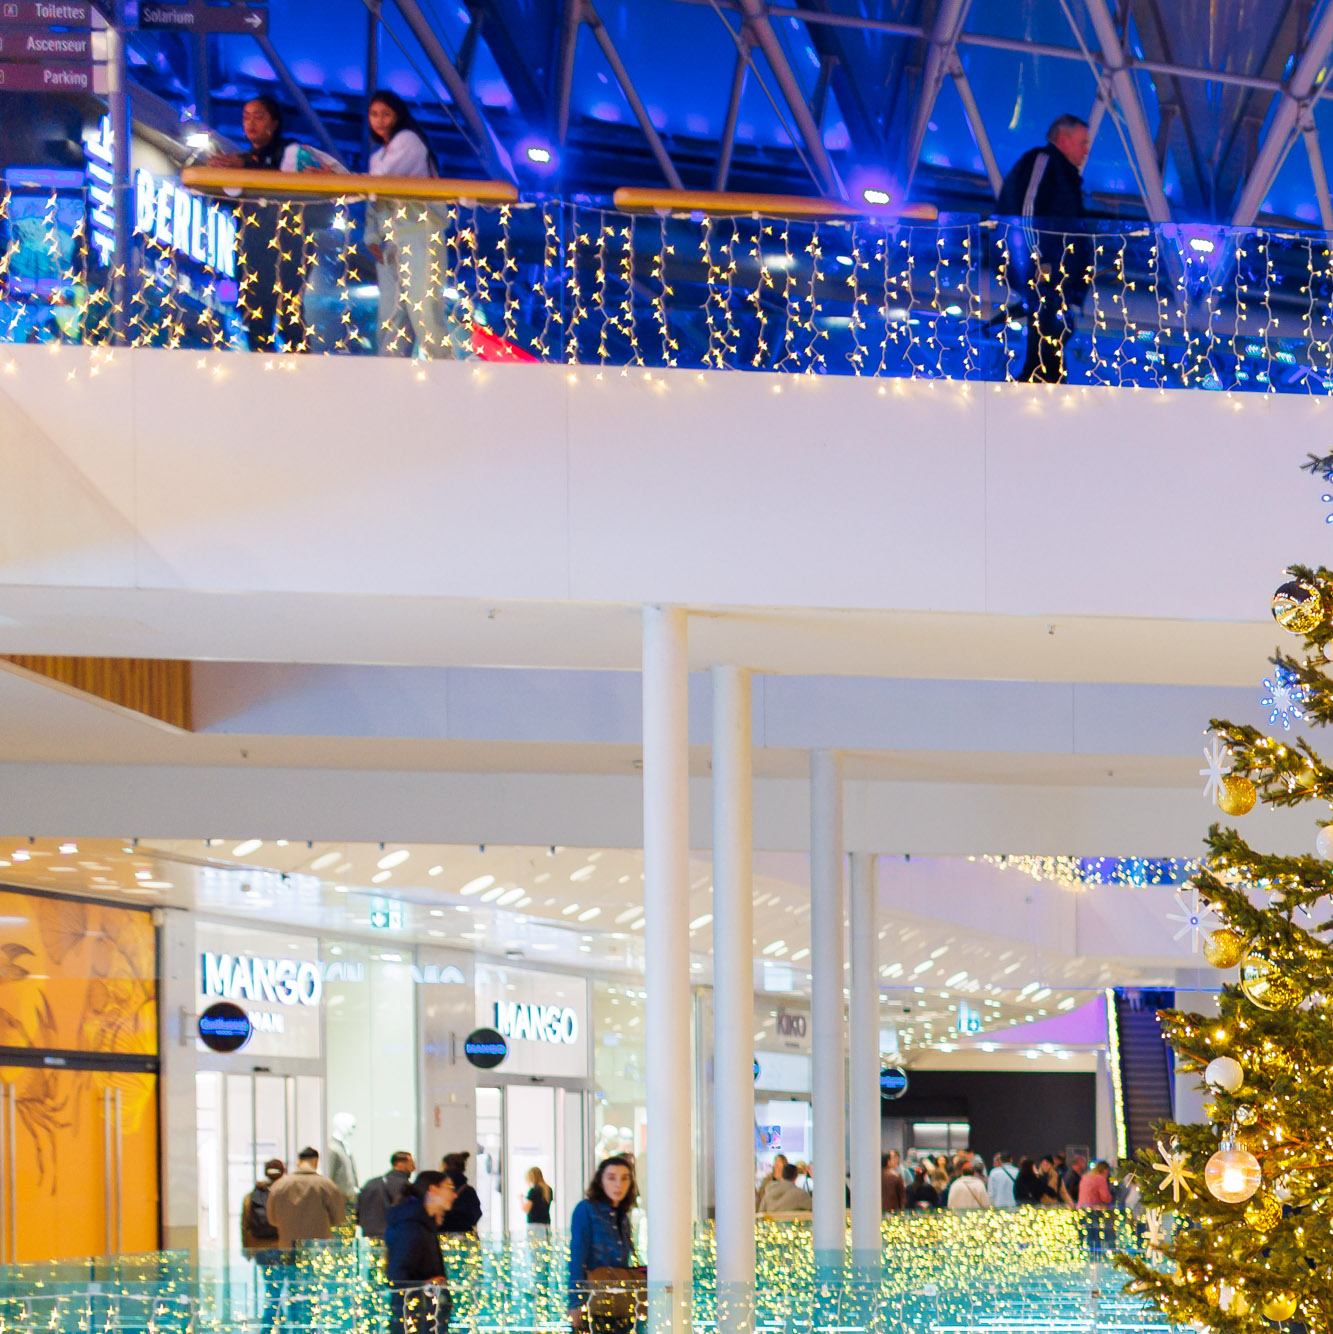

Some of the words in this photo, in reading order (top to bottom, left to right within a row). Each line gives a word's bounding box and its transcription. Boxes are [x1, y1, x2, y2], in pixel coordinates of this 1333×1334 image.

[36, 3, 86, 20] Toilettes
[143, 8, 195, 25] Solarium
[27, 36, 87, 52] Ascenseur
[44, 70, 88, 86] Parking
[136, 167, 236, 278] BERLIN
[201, 951, 323, 1006] MANGO
[494, 1001, 578, 1045] MANGO
